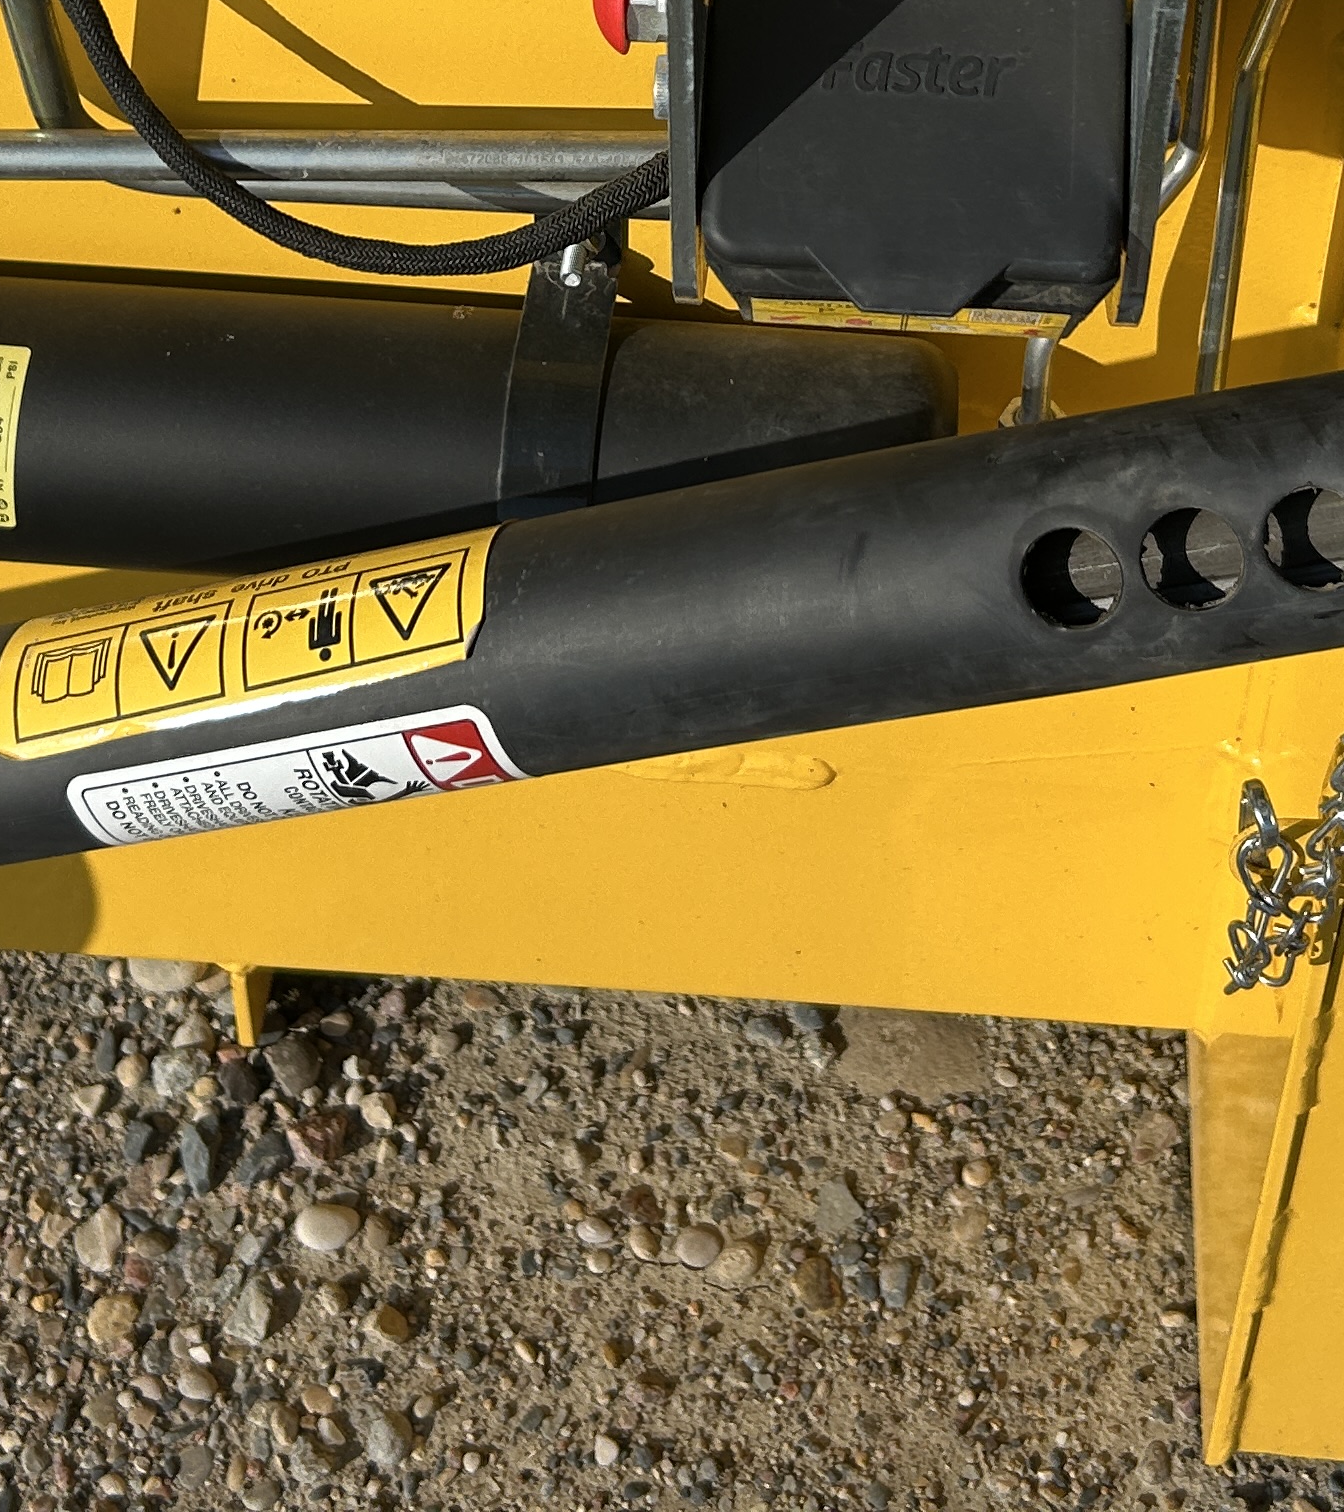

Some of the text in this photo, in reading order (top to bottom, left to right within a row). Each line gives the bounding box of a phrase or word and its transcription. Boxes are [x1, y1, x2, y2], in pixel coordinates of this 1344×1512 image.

[6, 360, 18, 379] PSI
[302, 562, 352, 578] PTO
[231, 574, 290, 592] drive
[152, 589, 216, 613] shaft
[200, 783, 224, 804] AND
[214, 780, 235, 800] ALL
[236, 781, 257, 802] DO
[105, 800, 127, 819] DO
[139, 792, 175, 826] FREELY
